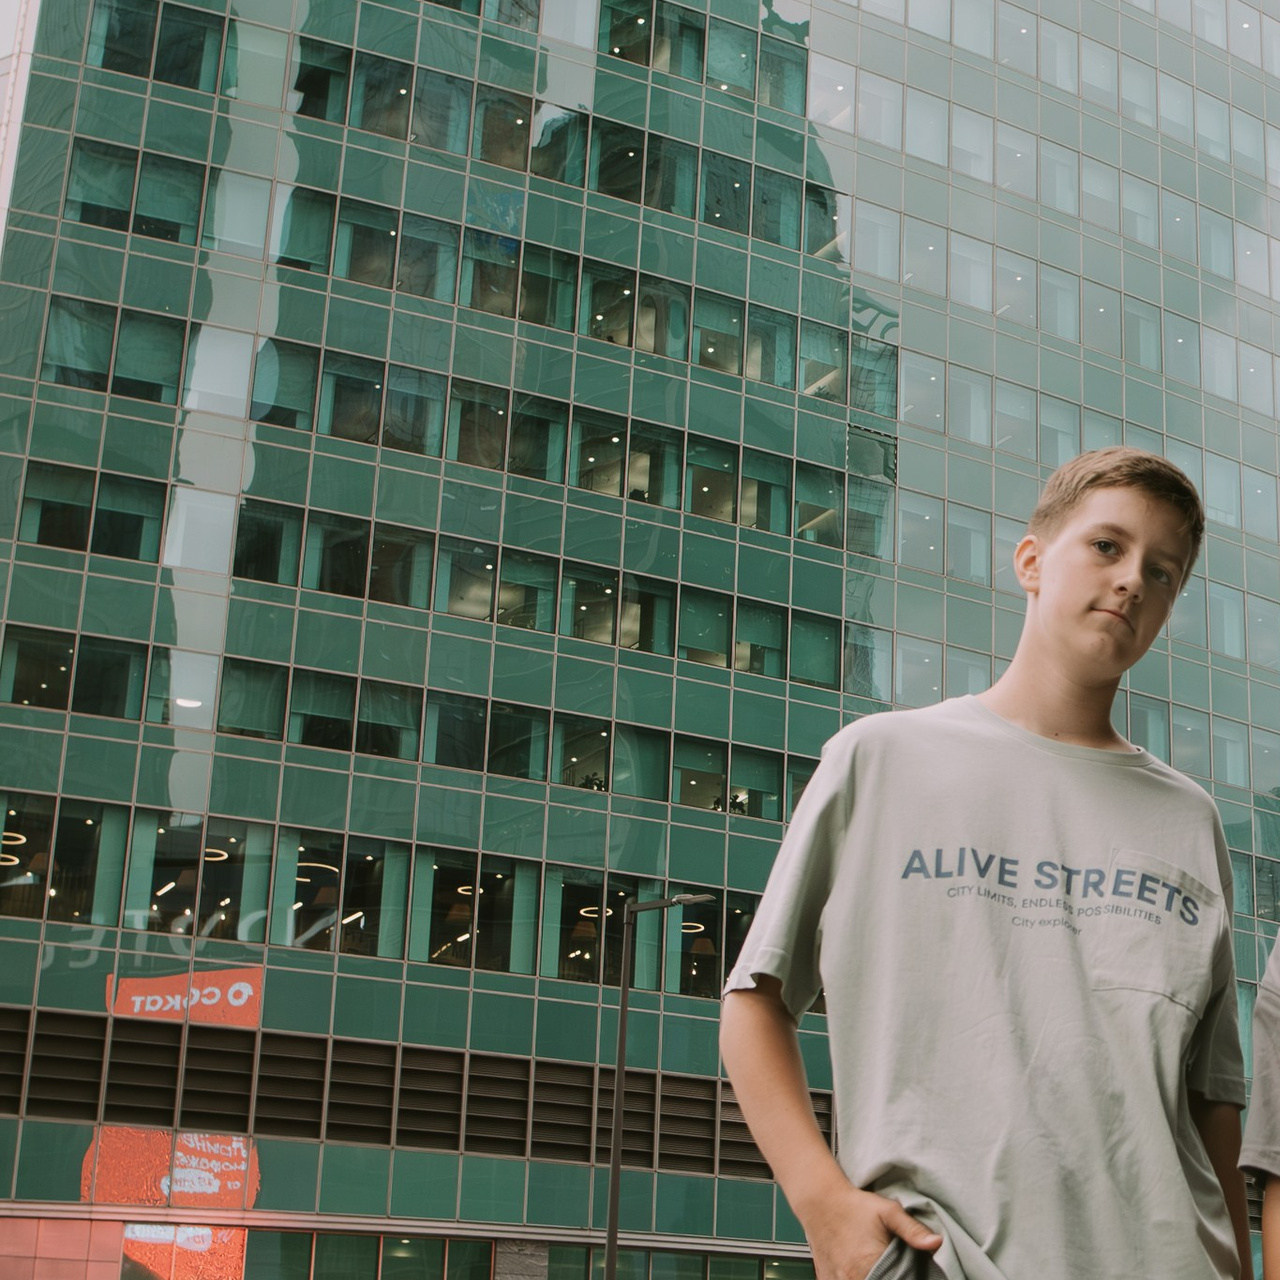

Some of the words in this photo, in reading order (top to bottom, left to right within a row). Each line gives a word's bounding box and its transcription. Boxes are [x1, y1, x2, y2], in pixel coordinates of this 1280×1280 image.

[901, 847, 1019, 888] ALIVE
[1034, 860, 1200, 926] STREETS
[947, 885, 975, 898] CITY
[977, 887, 1017, 909] LIMITS,
[1077, 903, 1163, 926] POSSIBILITIES
[1011, 915, 1036, 930] City
